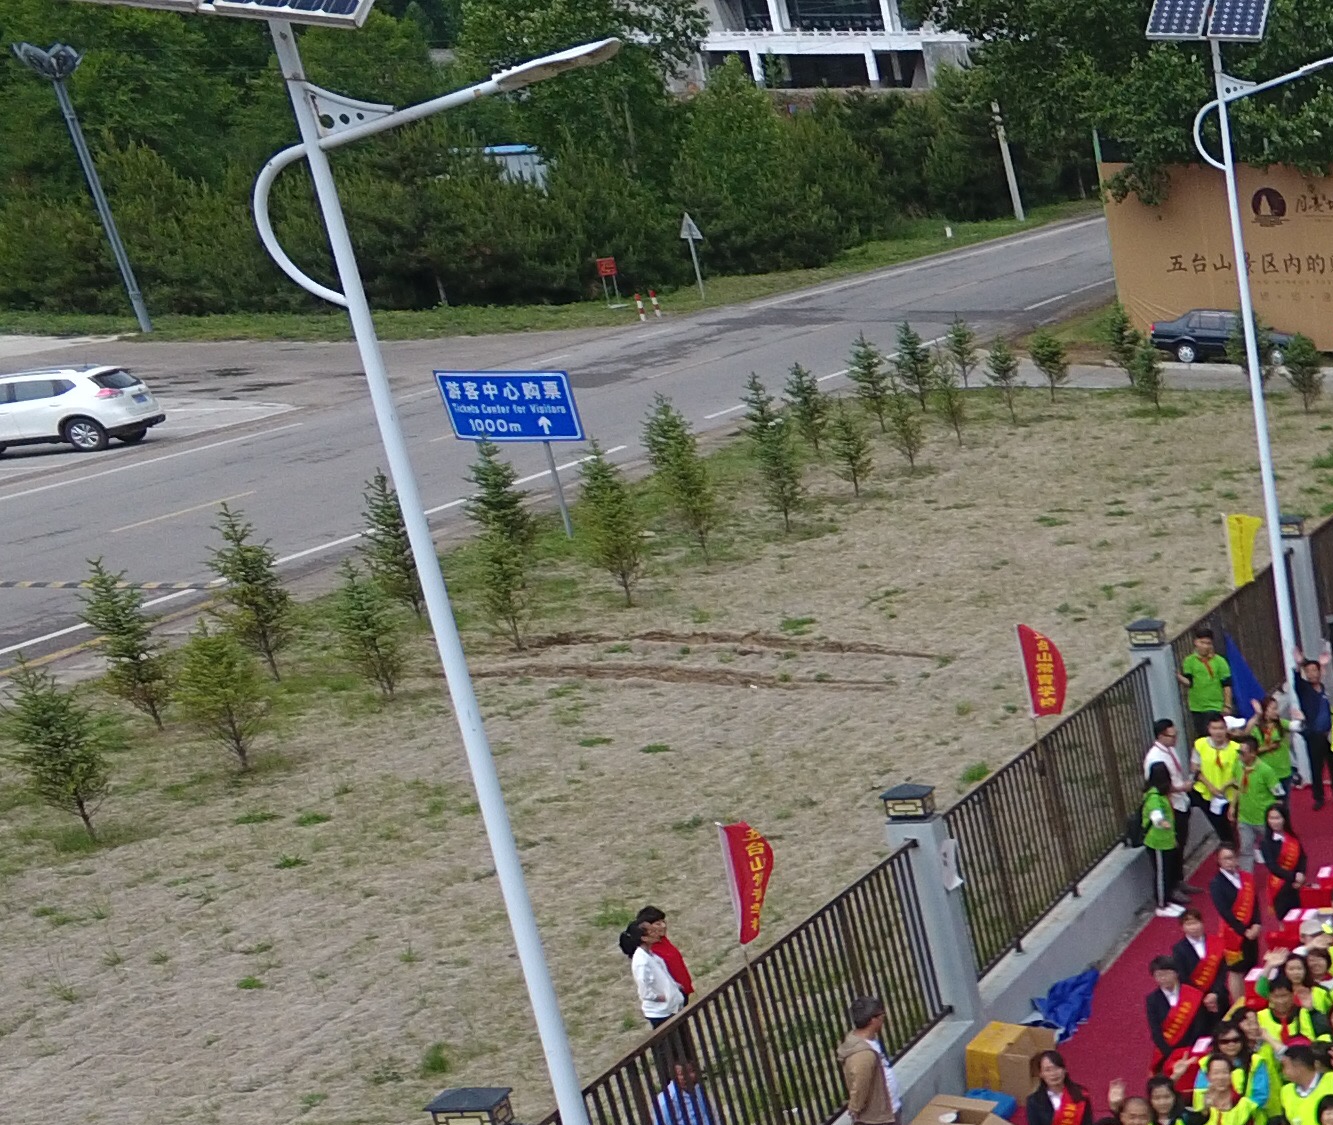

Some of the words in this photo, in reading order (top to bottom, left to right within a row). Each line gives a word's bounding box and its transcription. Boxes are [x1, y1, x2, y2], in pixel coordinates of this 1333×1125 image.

[445, 380, 562, 401] 游客中心购票
[481, 403, 510, 414] Center
[513, 403, 526, 414] for
[529, 403, 567, 415] Visitors
[468, 418, 522, 433] 1000m
